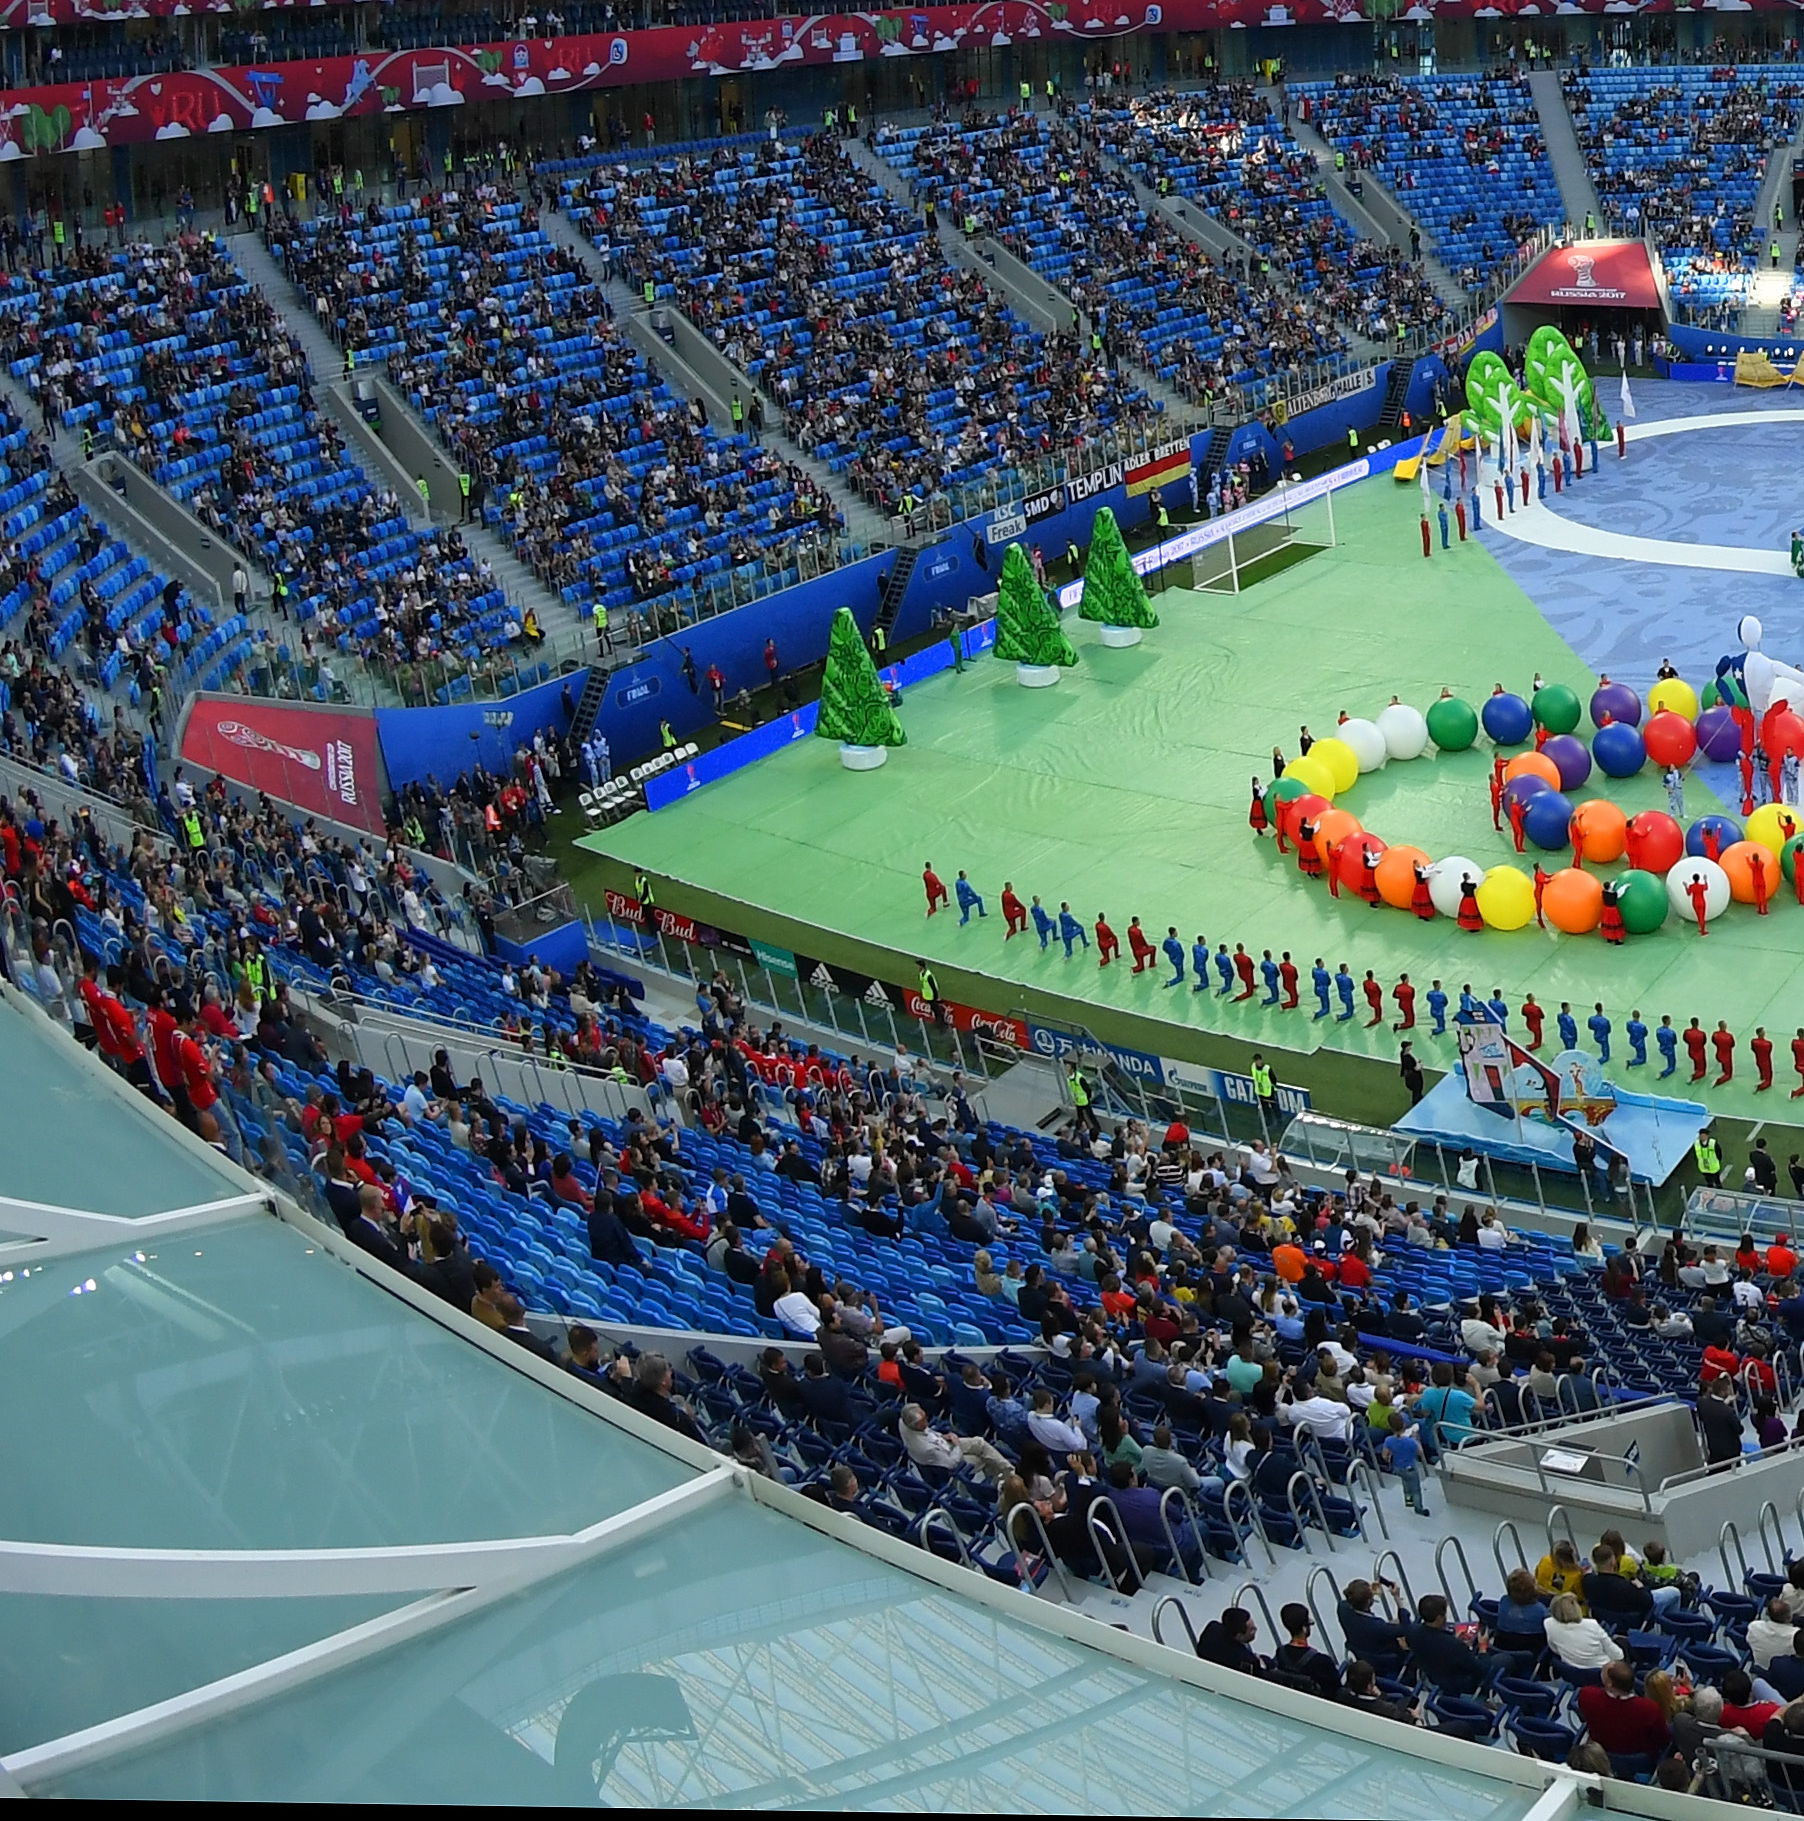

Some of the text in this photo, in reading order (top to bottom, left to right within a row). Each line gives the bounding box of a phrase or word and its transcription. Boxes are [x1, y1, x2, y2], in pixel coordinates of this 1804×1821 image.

[1066, 462, 1123, 502] TEMPLIN
[994, 503, 1017, 522] KSC
[1023, 496, 1050, 519] SMD
[990, 519, 1023, 541] Freak
[606, 892, 646, 923] Bud
[655, 909, 697, 941] Bud
[756, 949, 796, 971] Hisense
[810, 977, 841, 994] adidas
[864, 995, 896, 1012] adidas
[1224, 1076, 1306, 1116] GAZOM
